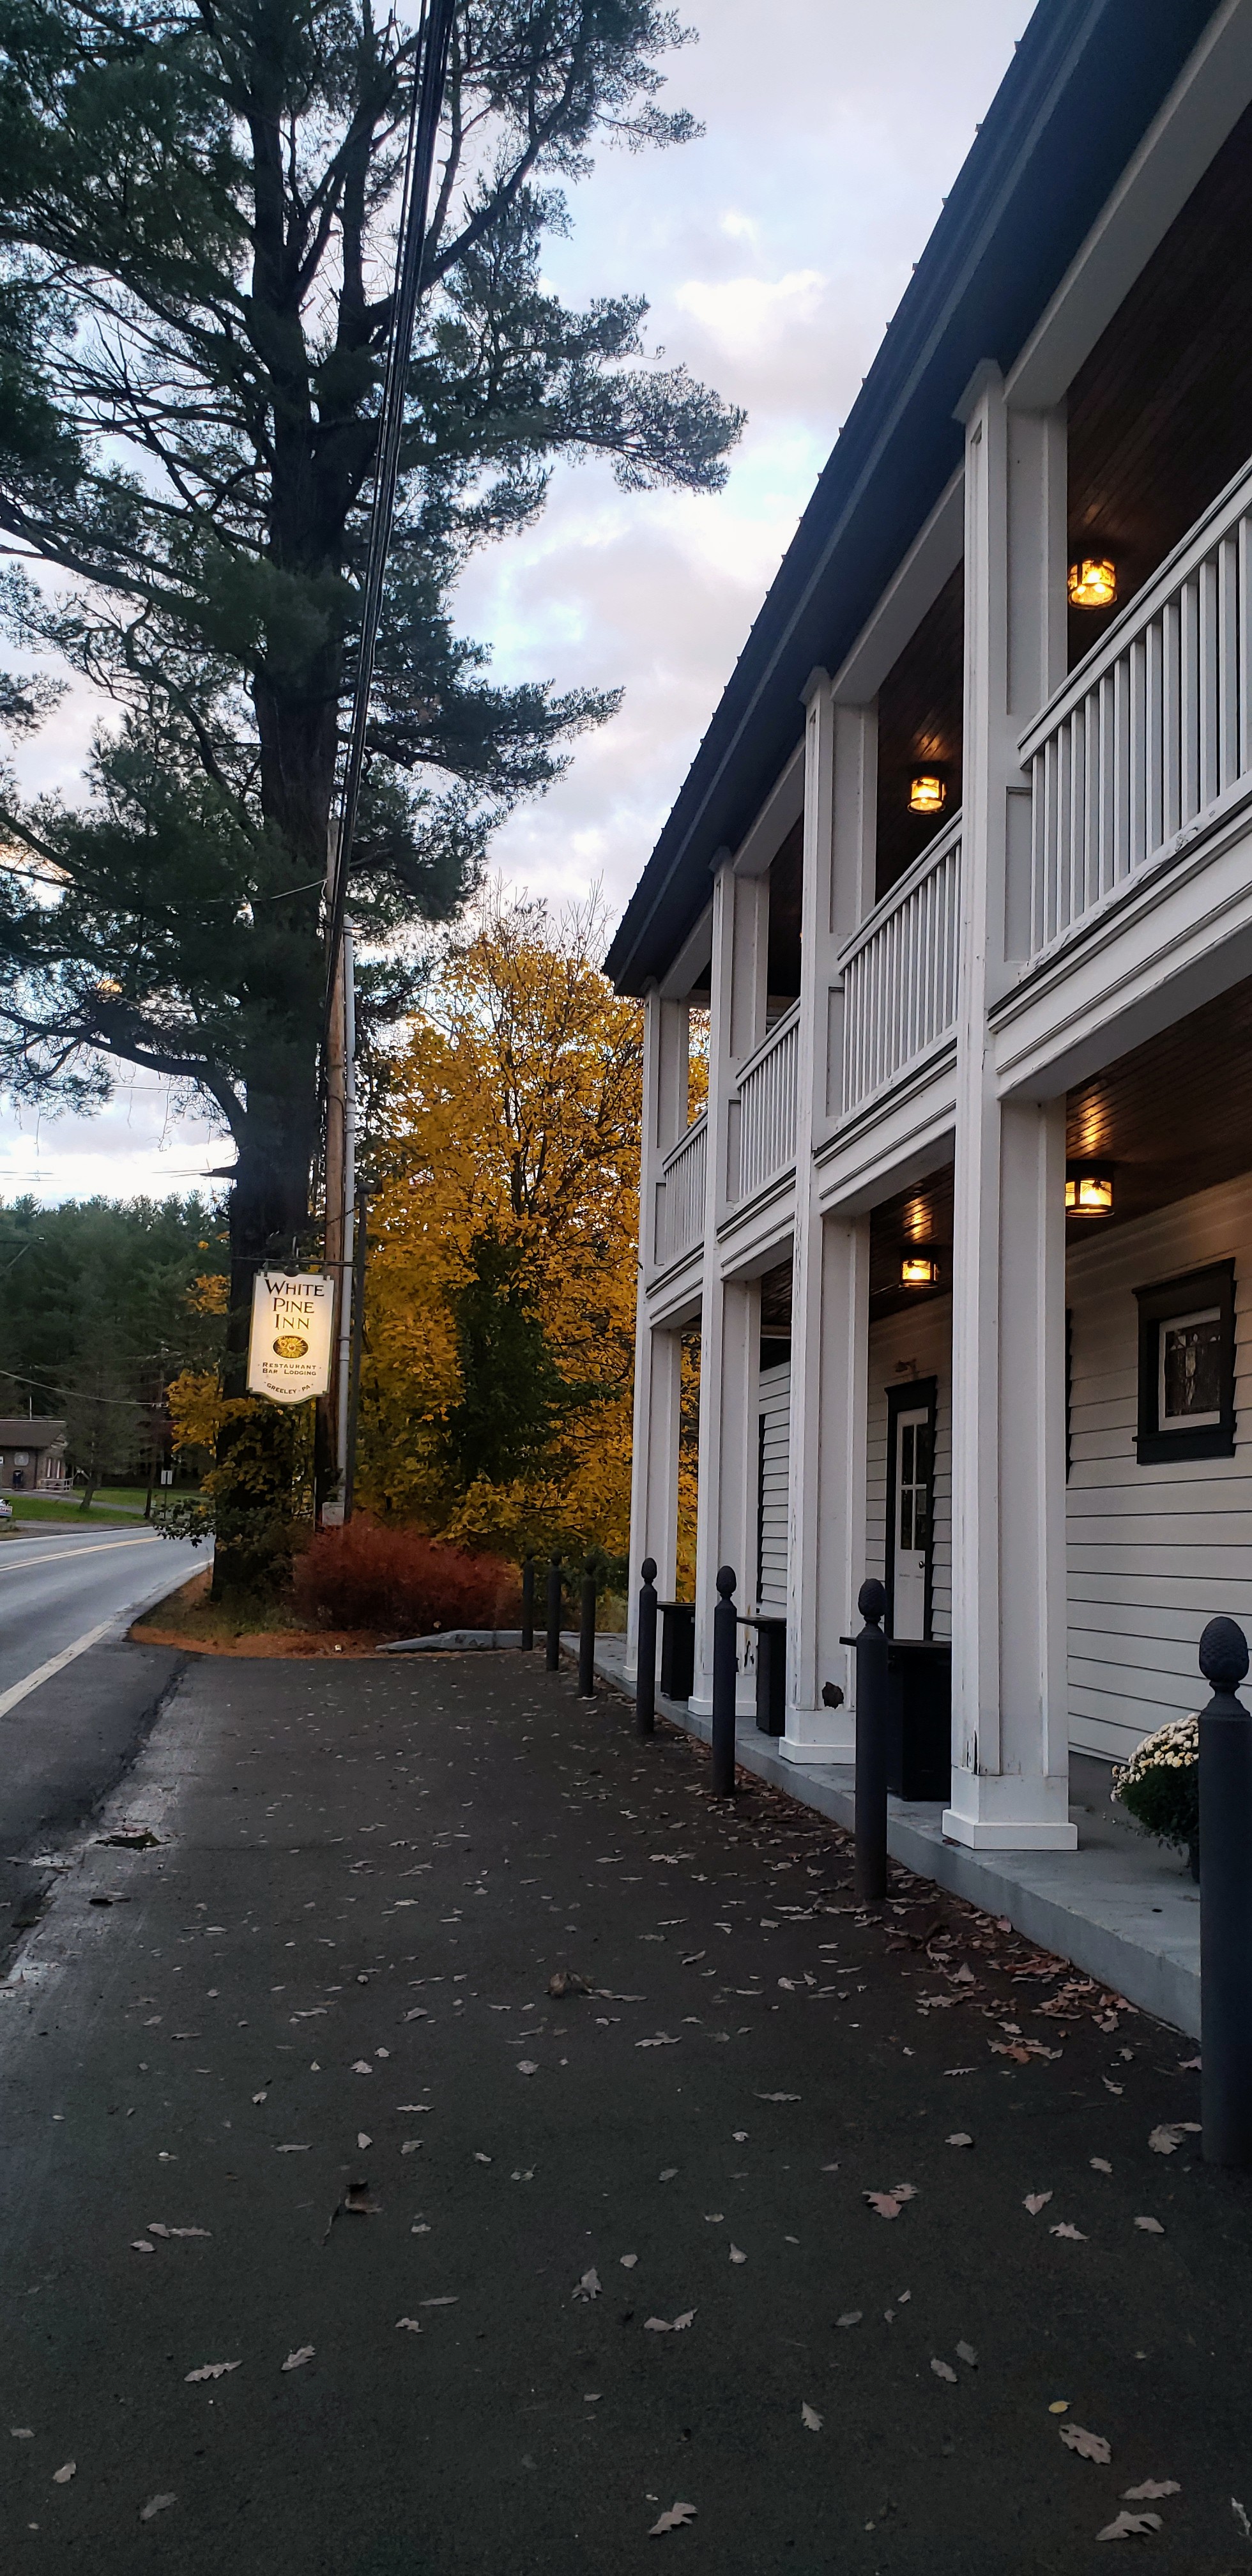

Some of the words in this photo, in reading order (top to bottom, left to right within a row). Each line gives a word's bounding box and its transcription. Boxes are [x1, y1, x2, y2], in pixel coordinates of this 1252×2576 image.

[264, 1279, 324, 1296] WHITE
[273, 1298, 315, 1314] PINE
[275, 1314, 310, 1330] INN
[266, 1383, 297, 1394] GREELEY
